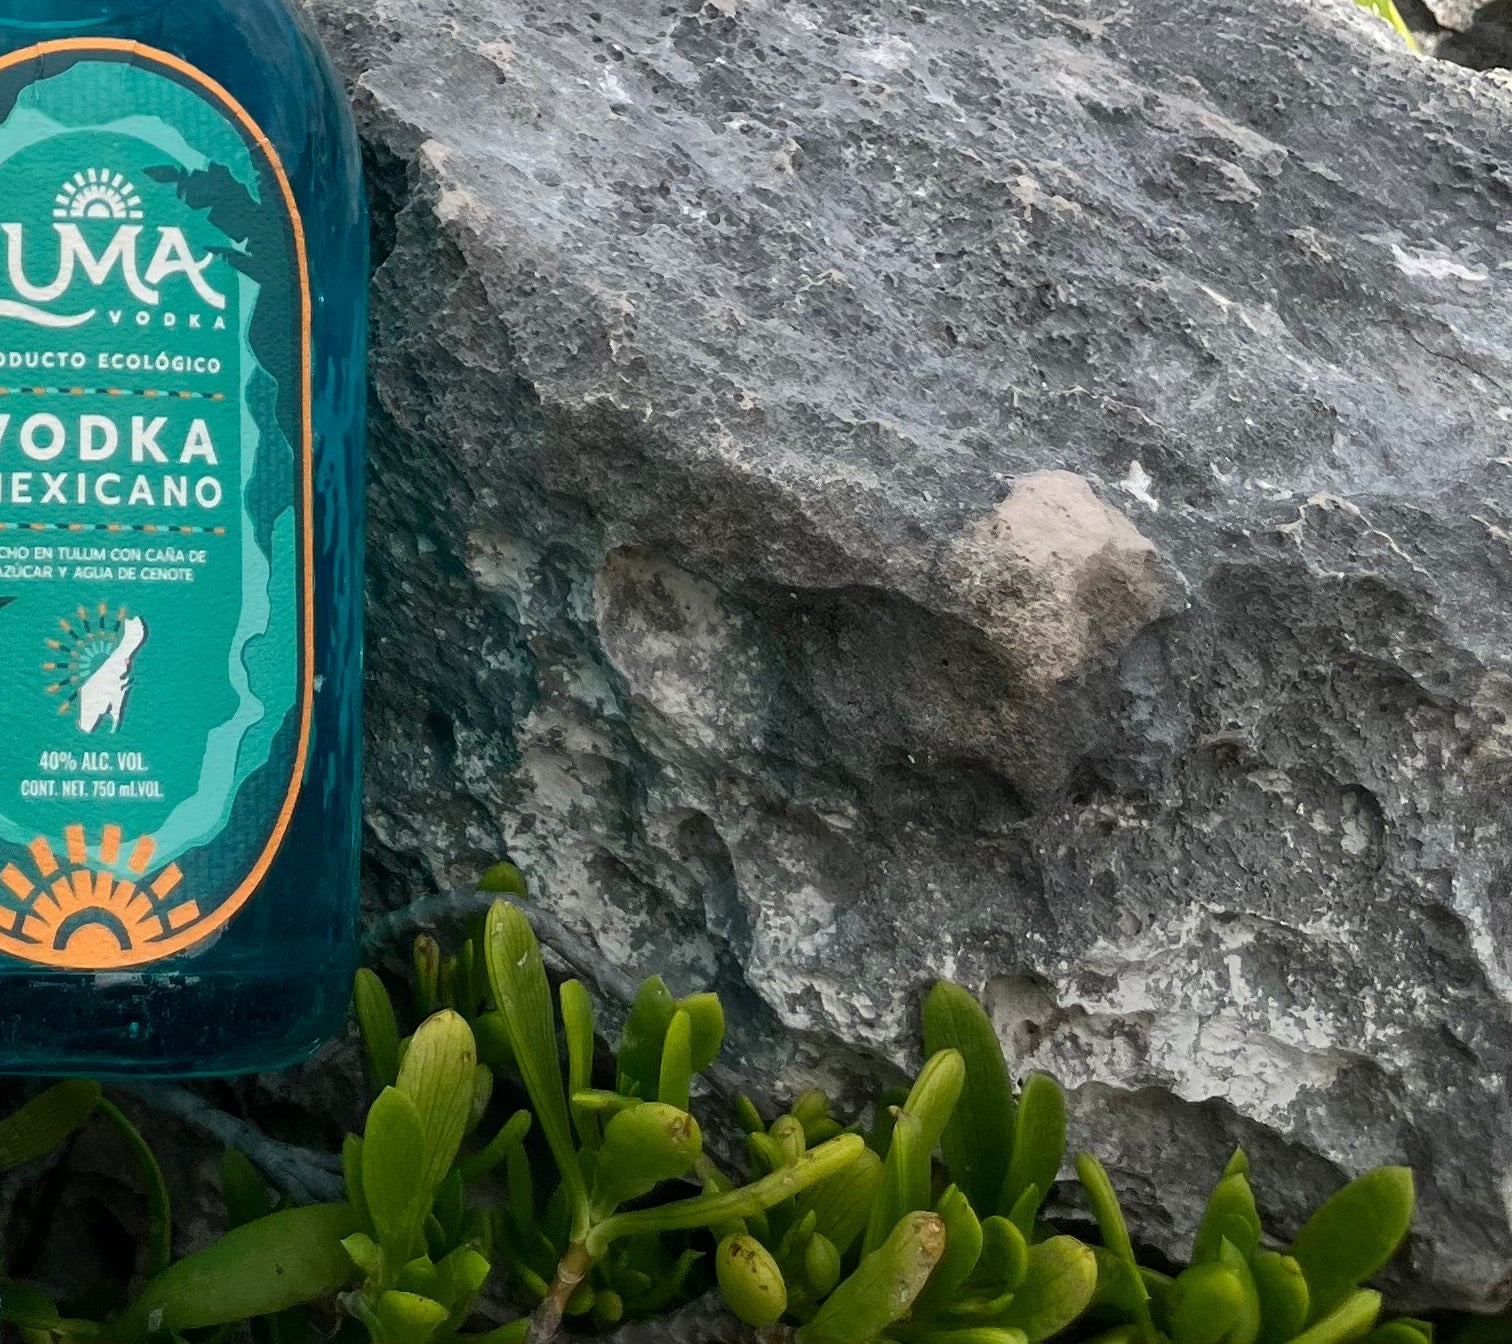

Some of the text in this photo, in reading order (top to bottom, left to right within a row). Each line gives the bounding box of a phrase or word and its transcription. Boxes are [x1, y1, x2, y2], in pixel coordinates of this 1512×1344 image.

[109, 310, 226, 330] VODKA
[98, 351, 221, 374] ECOLÓGICO
[34, 547, 53, 560] EN
[110, 548, 142, 562] CON
[145, 546, 185, 563] CAÑA
[189, 550, 207, 563] DE
[58, 566, 68, 579] Y
[72, 566, 114, 580] AGUA
[118, 567, 137, 580] DE
[140, 568, 194, 581] CENOTE
[39, 751, 149, 771] 40% ALC. VOL.
[20, 779, 59, 797] CONT.
[61, 780, 88, 797] NET.
[91, 780, 116, 797] 750
